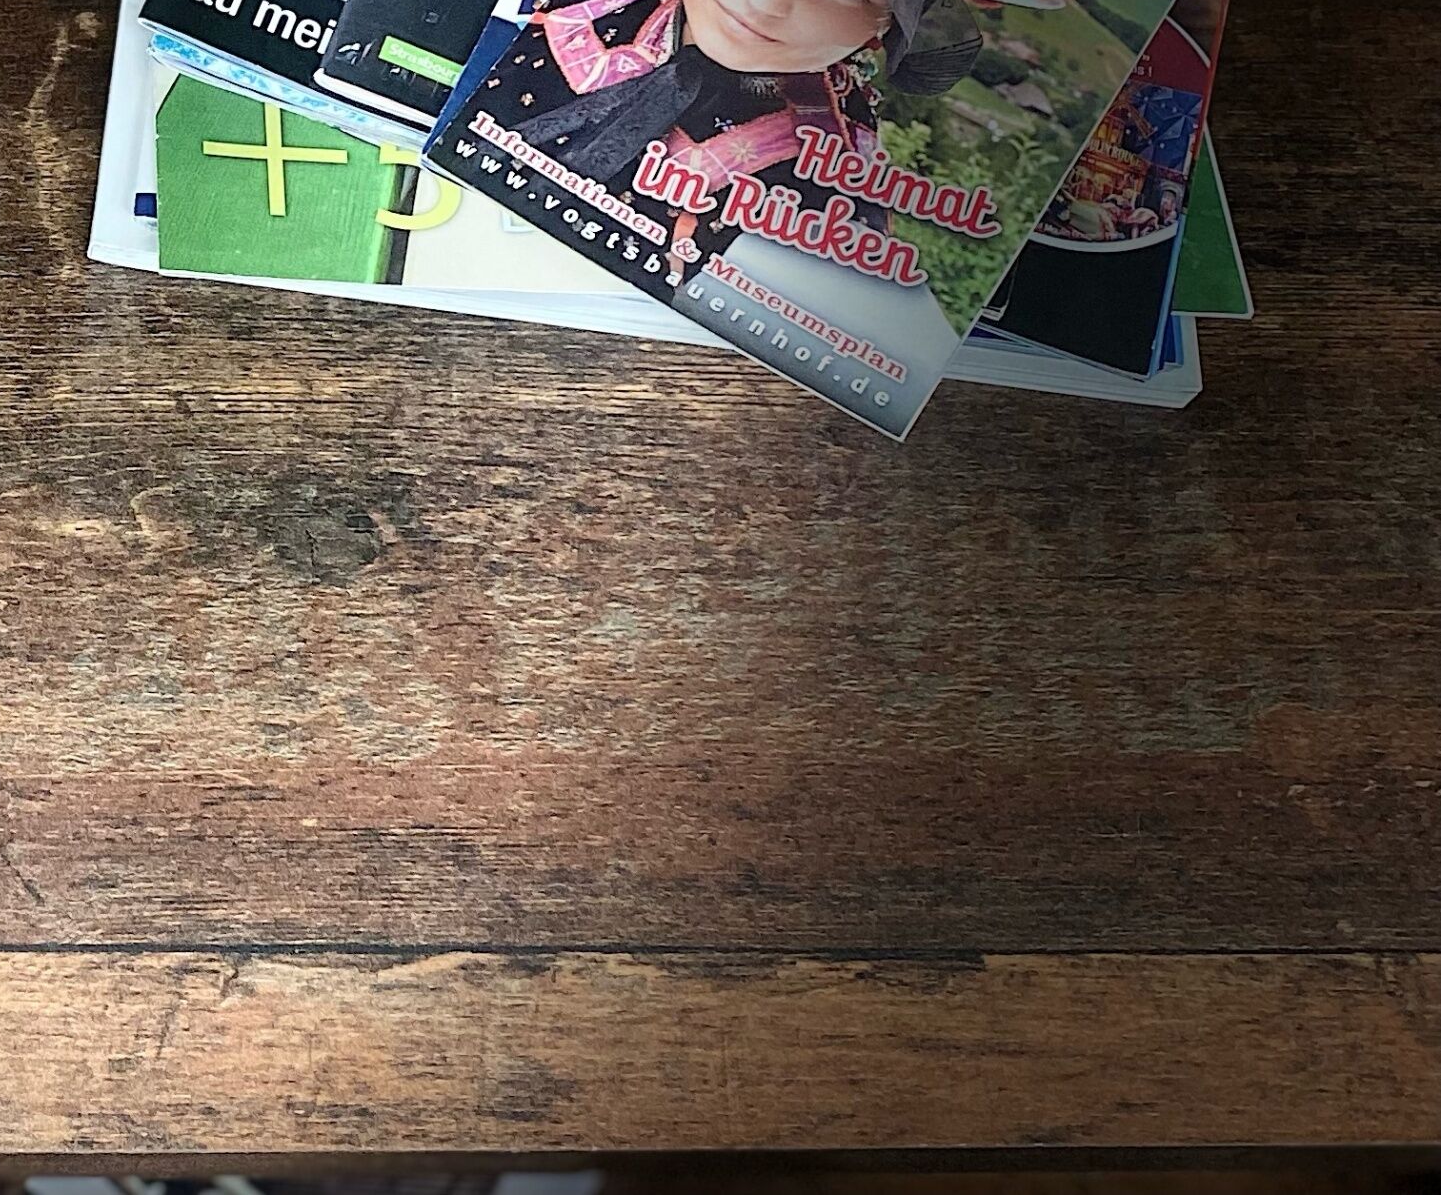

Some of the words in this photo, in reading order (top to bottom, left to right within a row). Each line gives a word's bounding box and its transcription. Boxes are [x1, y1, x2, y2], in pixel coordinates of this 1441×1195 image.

[469, 110, 668, 247] Informationen
[673, 236, 702, 264] &
[704, 251, 909, 385] Museumsplan
[633, 140, 718, 217] im
[720, 173, 930, 288] Rücken
[796, 125, 1003, 239] Heimat
